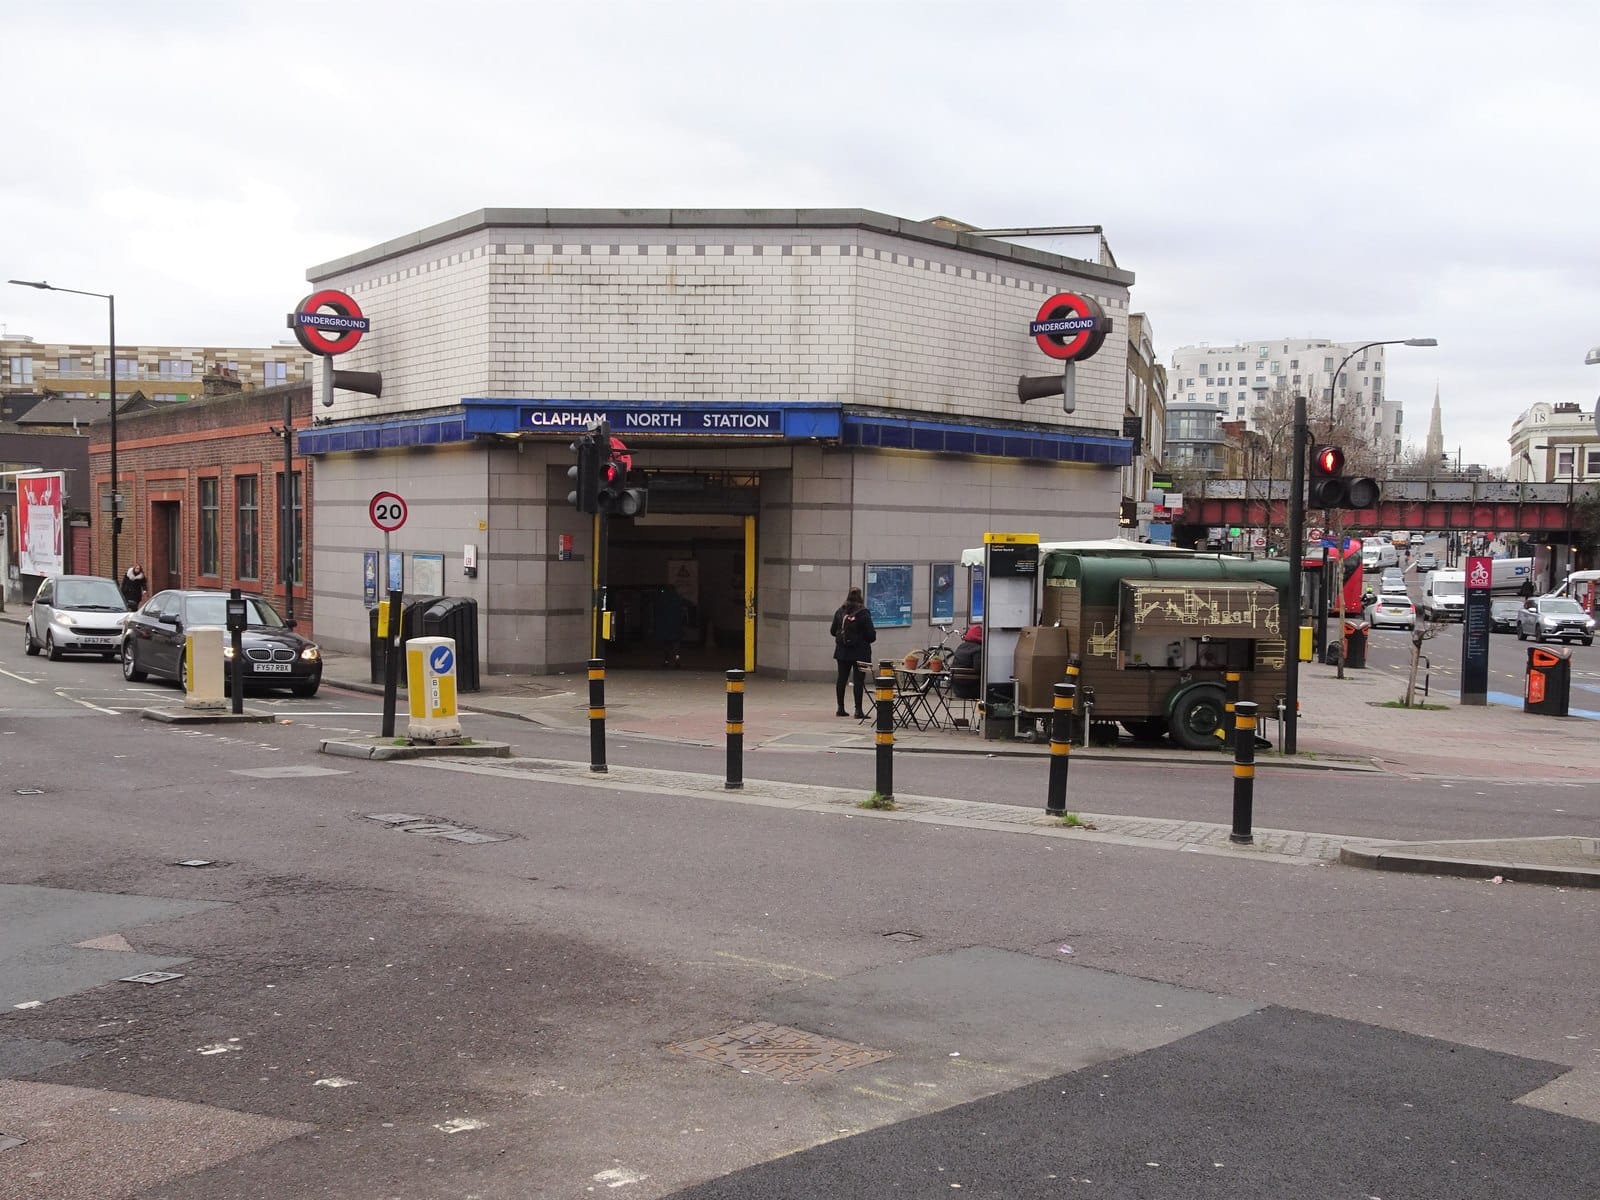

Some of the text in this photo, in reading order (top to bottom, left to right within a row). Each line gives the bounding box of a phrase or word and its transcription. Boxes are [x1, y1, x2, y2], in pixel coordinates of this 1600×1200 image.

[300, 315, 366, 329] UNDERGROUND
[1033, 319, 1094, 332] UNDERGROUND
[531, 411, 769, 428] CLAPHAM NORTH STATION
[376, 504, 402, 520] 20
[256, 663, 289, 672] FY57 RBX
